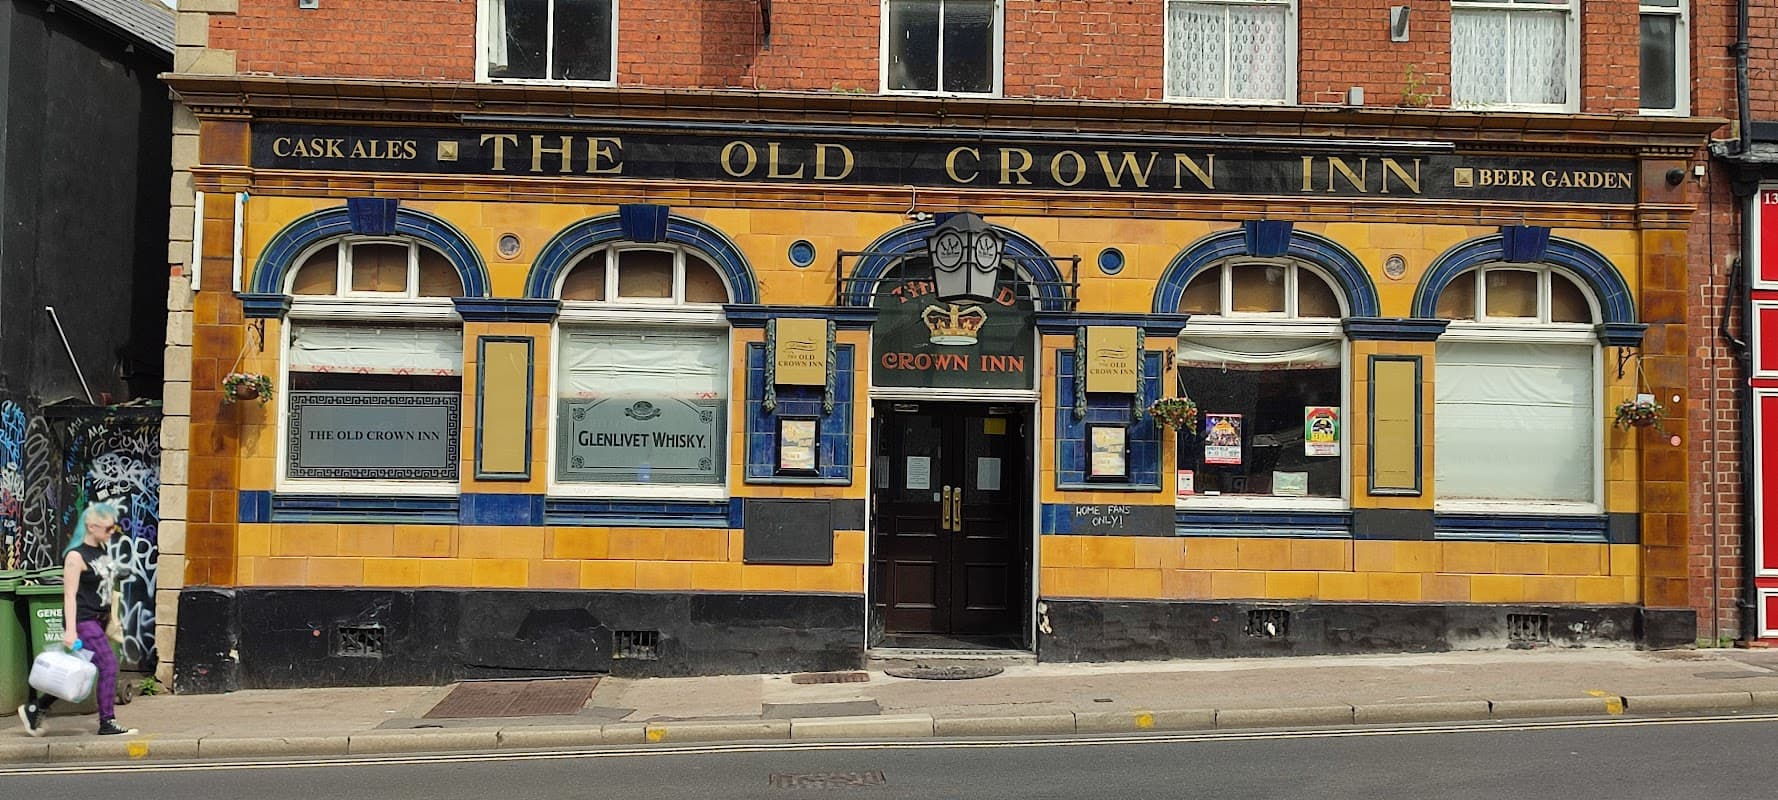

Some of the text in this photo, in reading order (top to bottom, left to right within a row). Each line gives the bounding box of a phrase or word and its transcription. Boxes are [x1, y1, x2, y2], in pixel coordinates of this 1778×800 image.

[272, 137, 417, 160] CASK ALES
[480, 133, 1422, 194] THE OLD CROWN INN
[1478, 169, 1633, 189] BEER GARDEN
[881, 352, 1025, 373] CROWN INN
[309, 430, 440, 441] THE OLD CROWN INN
[578, 430, 706, 449] GLENLIVET WHISKY.
[1075, 505, 1131, 517] HOME FANS
[1091, 515, 1124, 528] ONLY!
[36, 608, 63, 618] GENE
